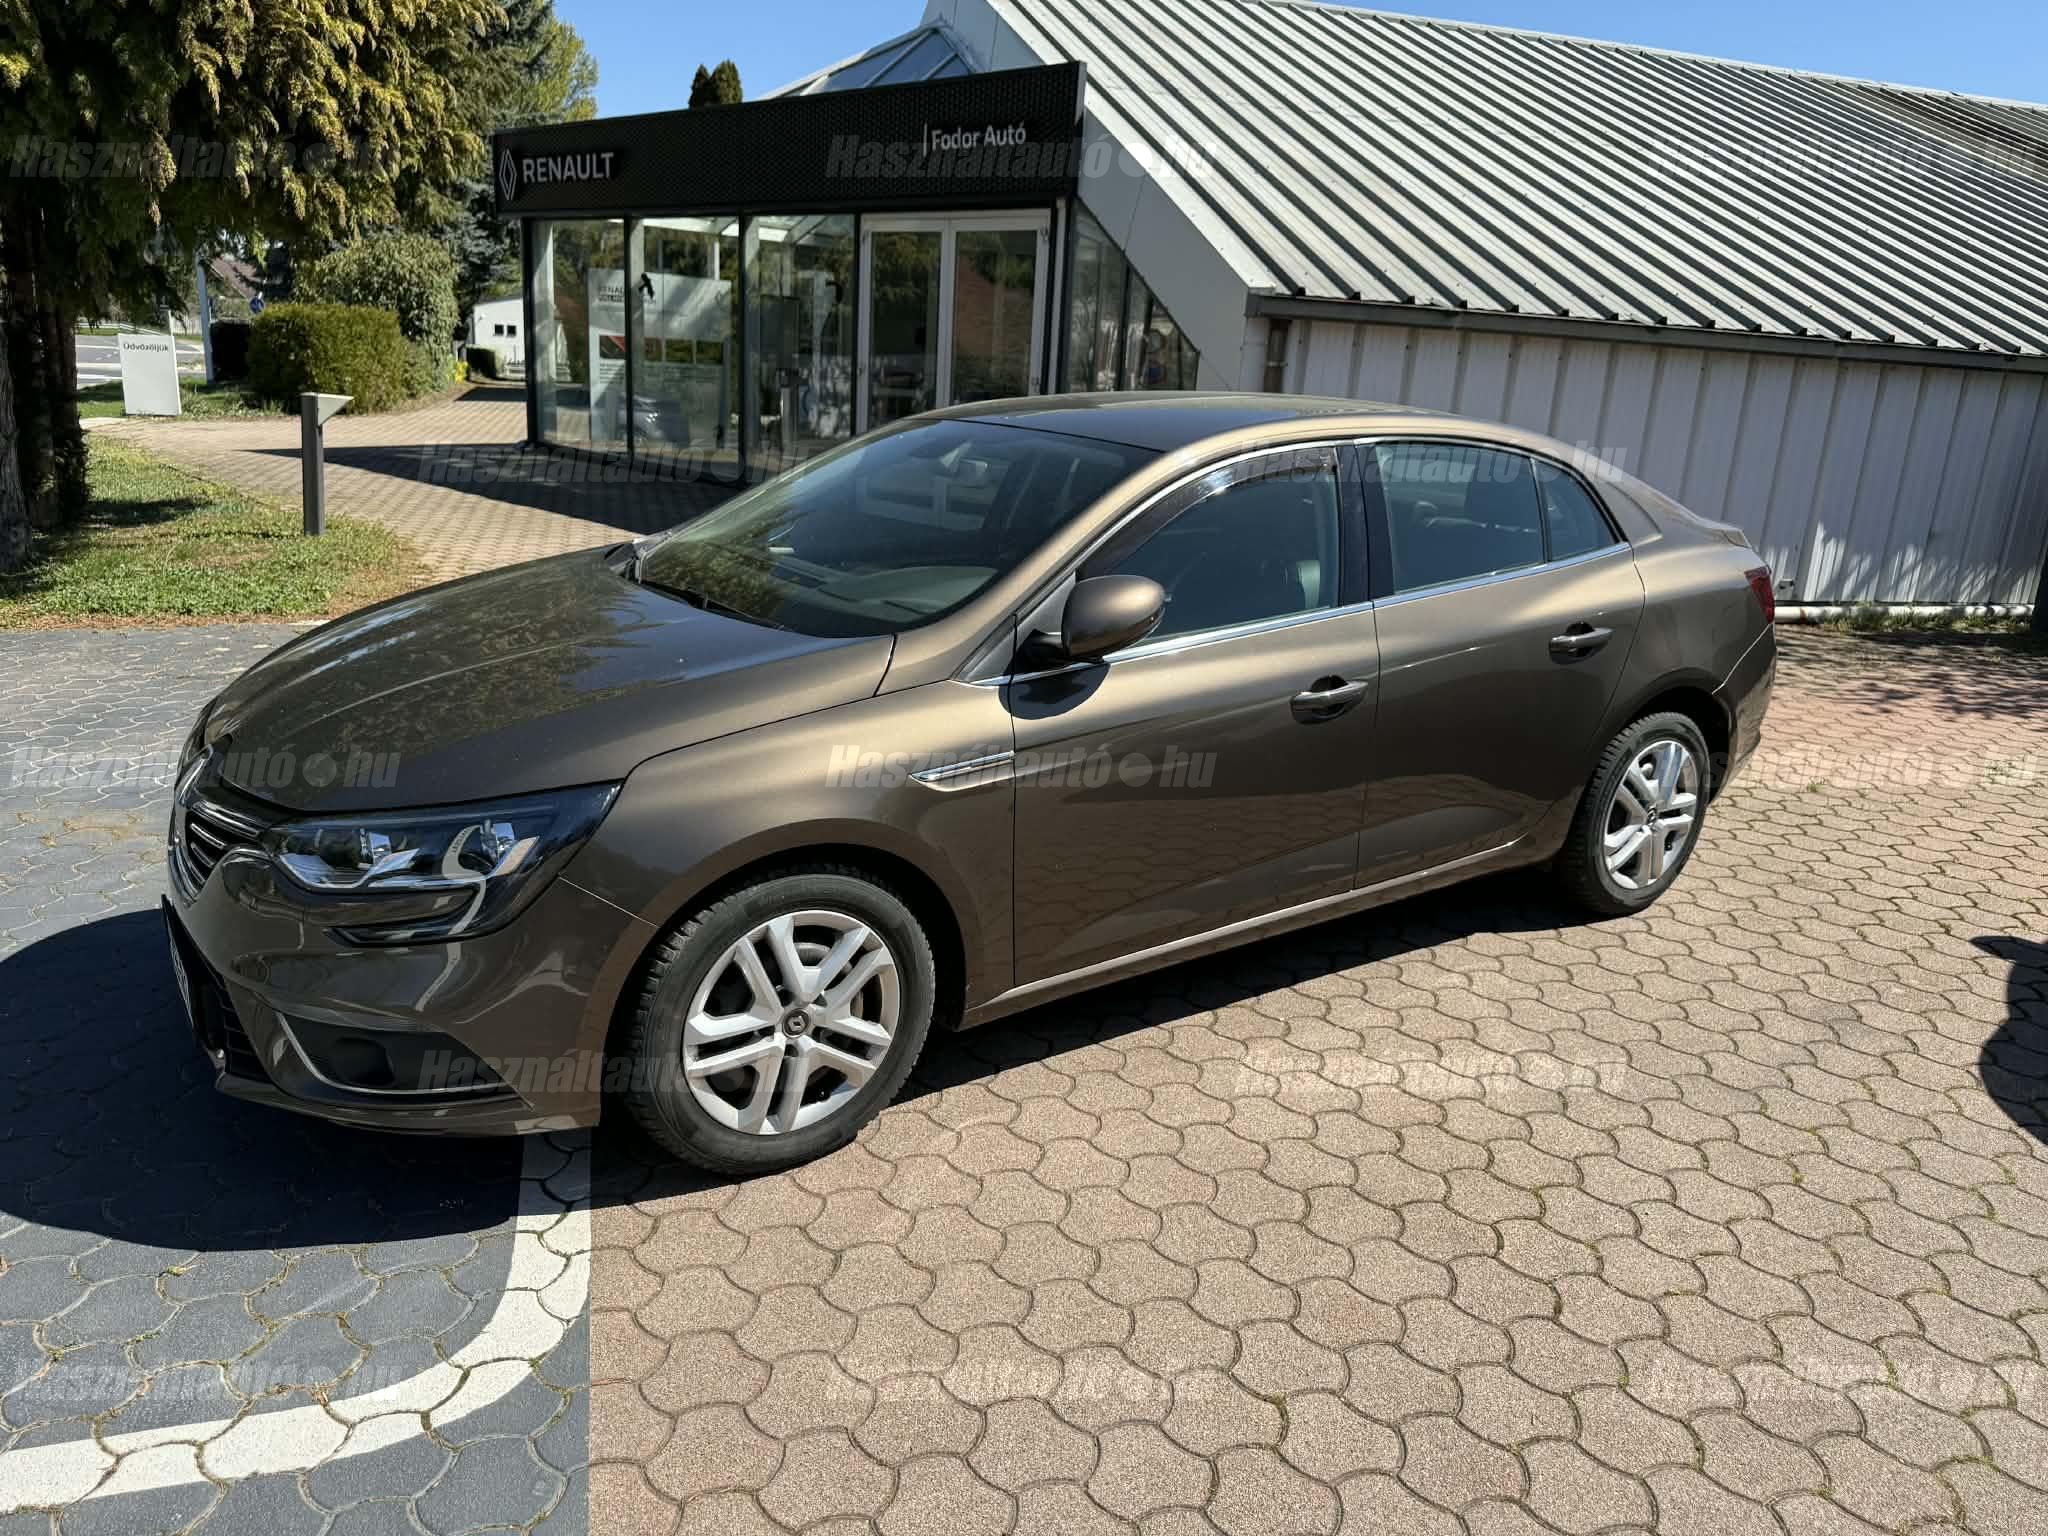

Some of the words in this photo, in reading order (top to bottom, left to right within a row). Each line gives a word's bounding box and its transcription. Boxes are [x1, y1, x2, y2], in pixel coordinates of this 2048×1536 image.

[931, 126, 980, 151] Fodor
[984, 120, 1026, 147] Autó
[522, 152, 614, 183] RENAULT
